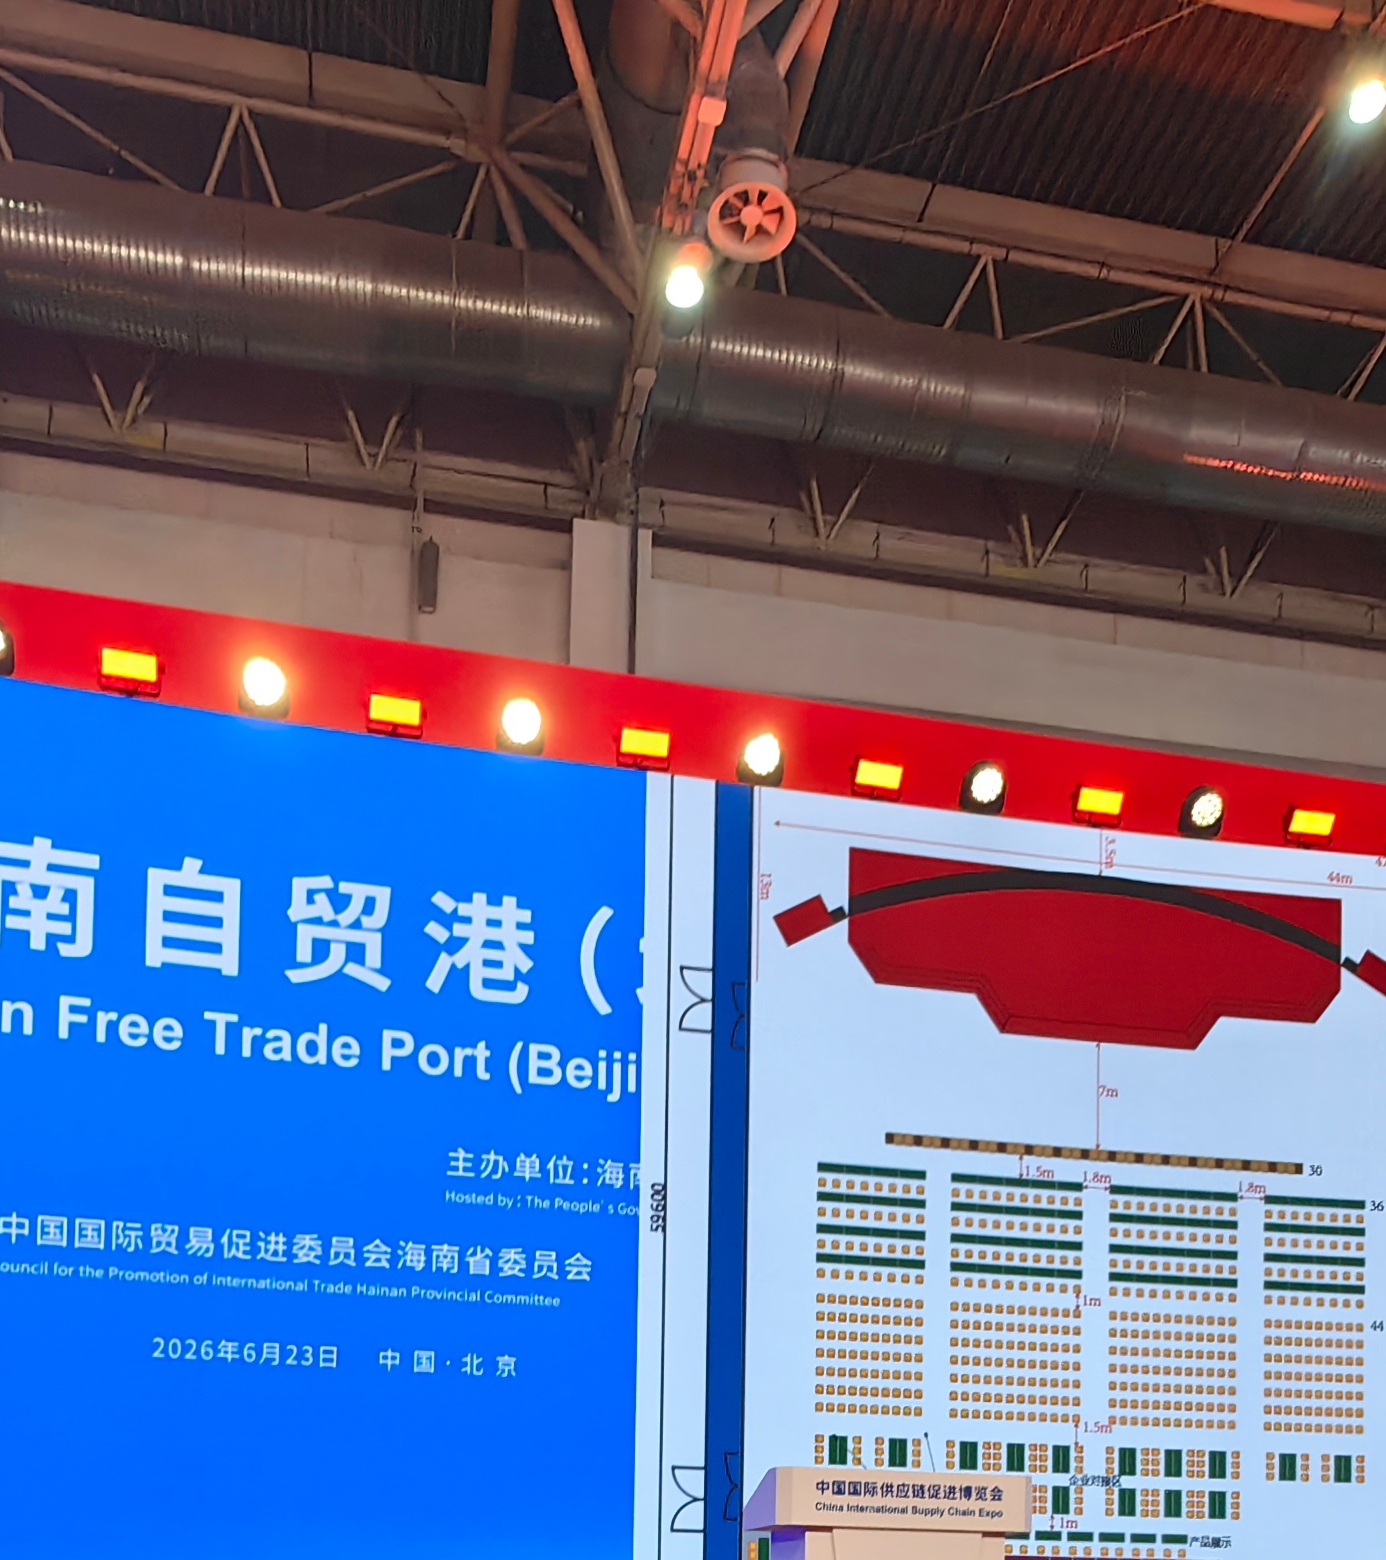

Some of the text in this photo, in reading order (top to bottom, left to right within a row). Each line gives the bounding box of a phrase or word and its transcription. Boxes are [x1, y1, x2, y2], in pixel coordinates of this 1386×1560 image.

[58, 995, 184, 1052] Free
[204, 1010, 361, 1069] Trade
[380, 1027, 492, 1085] Port
[509, 1041, 637, 1103] (Beiji
[1025, 1165, 1054, 1179] 1.5m
[1083, 1171, 1112, 1185] 1.8m
[445, 1189, 494, 1206] Hosted
[526, 1195, 551, 1209] The
[650, 1182, 666, 1236] 59600
[53, 1261, 75, 1277] for
[79, 1264, 104, 1279] the
[109, 1267, 189, 1286] Promotion
[193, 1271, 208, 1286] of
[212, 1273, 308, 1293] International
[313, 1279, 353, 1296] Trade
[356, 1282, 408, 1298] Hainan
[411, 1285, 481, 1303] Provincial
[484, 1290, 561, 1308] Committee
[152, 1337, 338, 1370] 2026年6月23日
[815, 1479, 1004, 1502] 中国国际供应链促进博览会
[815, 1501, 1004, 1519] China International Supply Chain Expo
